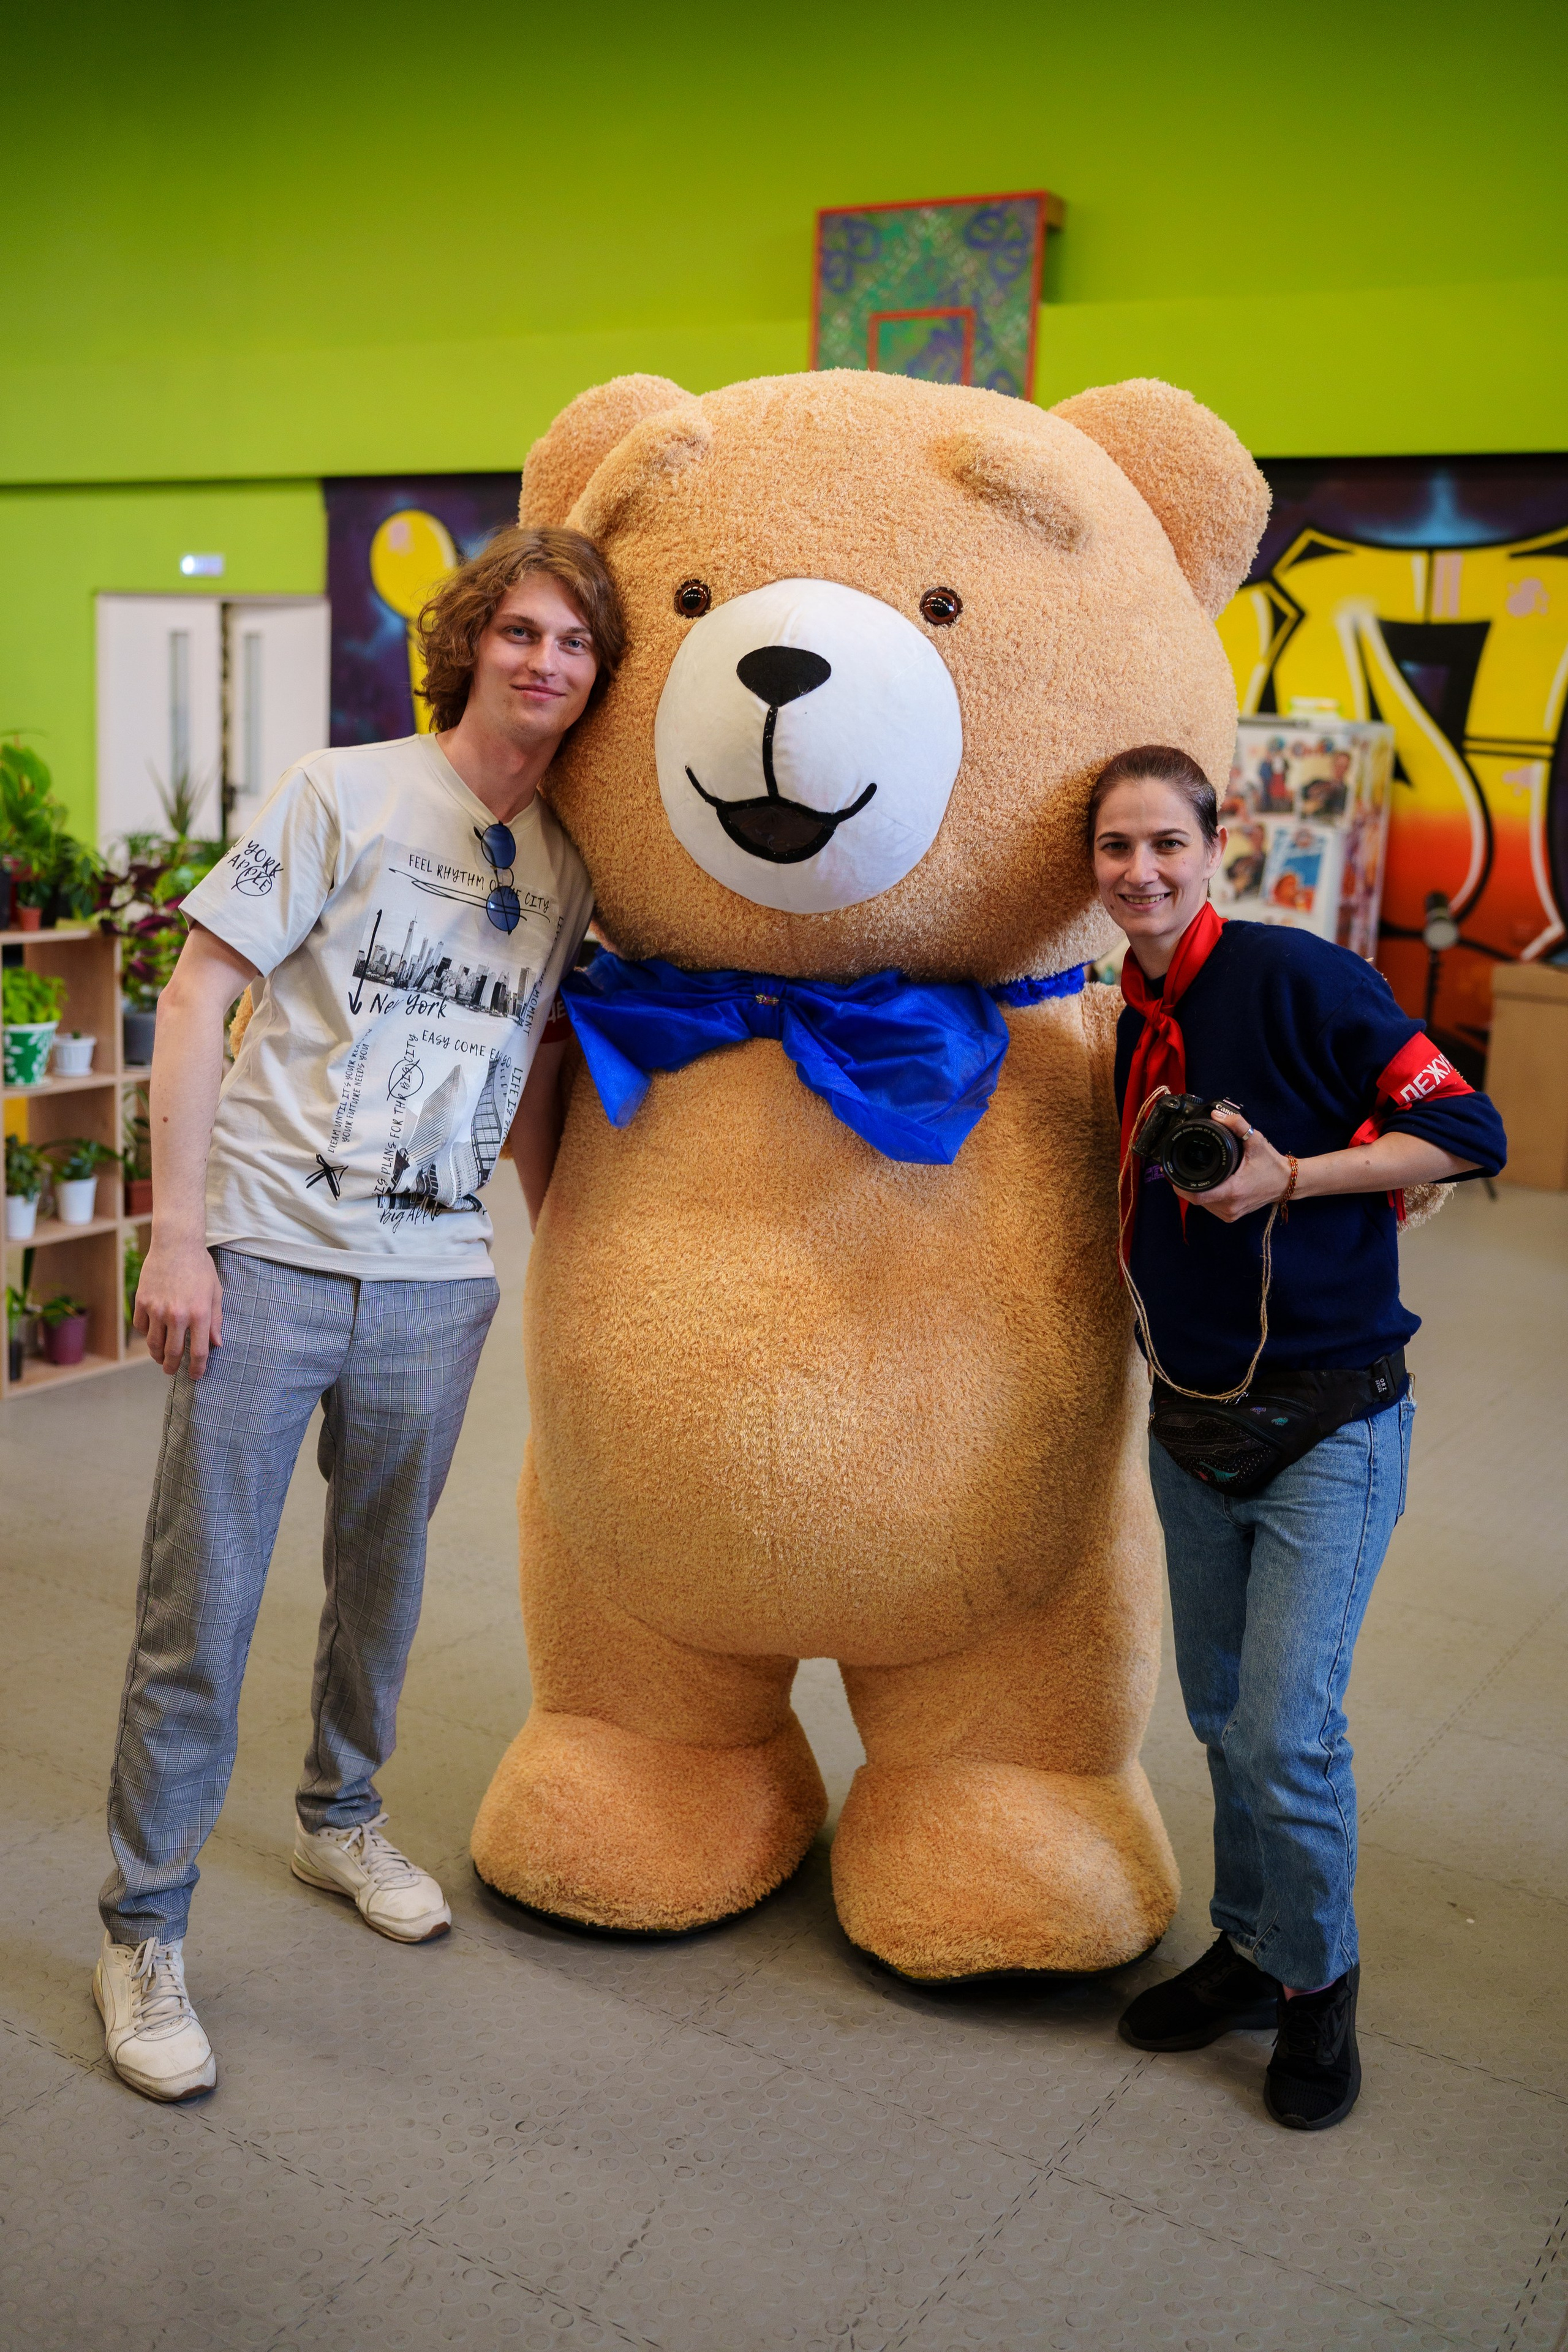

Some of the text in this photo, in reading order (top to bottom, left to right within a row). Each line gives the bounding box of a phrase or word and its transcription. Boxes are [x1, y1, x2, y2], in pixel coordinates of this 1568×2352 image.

[244, 840, 284, 878] YORK
[227, 854, 271, 892] APPLE
[409, 854, 432, 873] FEEL
[437, 864, 484, 891] RHYTHM
[525, 892, 549, 913] CITY
[405, 993, 447, 1019] York
[523, 989, 540, 1037] MOMENT
[404, 1033, 418, 1063] CITY
[422, 1030, 450, 1049] EASY
[454, 1039, 486, 1057] COME
[345, 1060, 356, 1080] YOUR
[399, 1067, 412, 1090] BIG
[510, 1067, 523, 1097] LIFE
[342, 1082, 351, 1099] IT'S
[342, 1043, 369, 1142] YOUR FUTURE NEEDS YOU
[334, 1102, 347, 1127] UNTIL
[507, 1098, 516, 1117] IS
[1215, 1104, 1236, 1115] Cano
[327, 1129, 341, 1153] DREAM
[390, 1118, 404, 1139] FOR
[381, 1142, 397, 1175] PLANS
[380, 1203, 442, 1234] Big Apple
